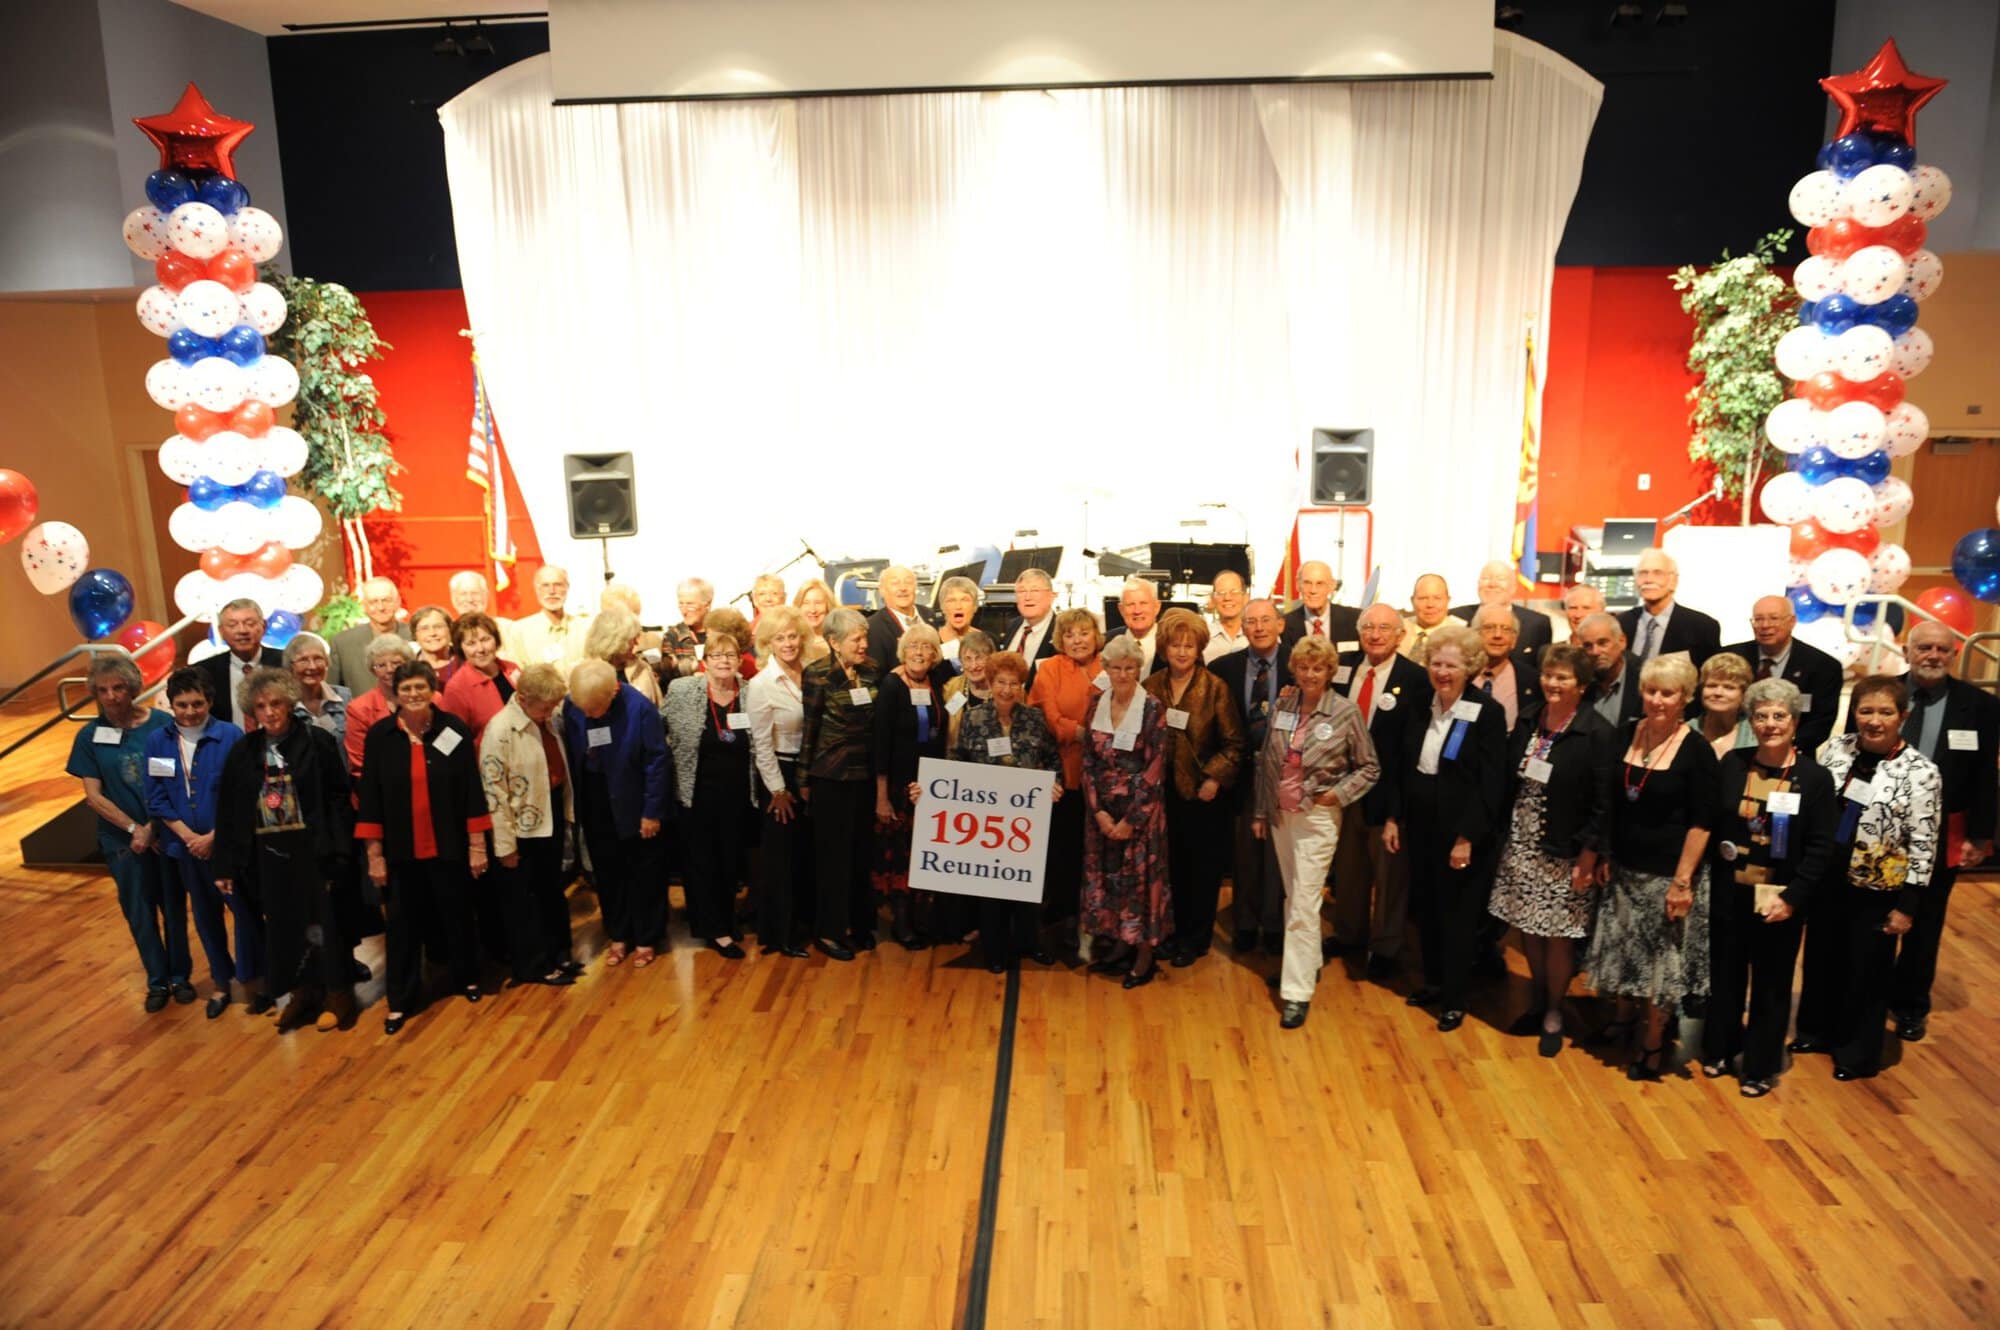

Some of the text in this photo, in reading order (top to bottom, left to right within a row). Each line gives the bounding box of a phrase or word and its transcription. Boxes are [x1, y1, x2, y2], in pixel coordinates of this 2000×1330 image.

[929, 778, 1043, 809] Class of
[930, 810, 1032, 853] 1958
[920, 850, 1033, 883] Reunion
